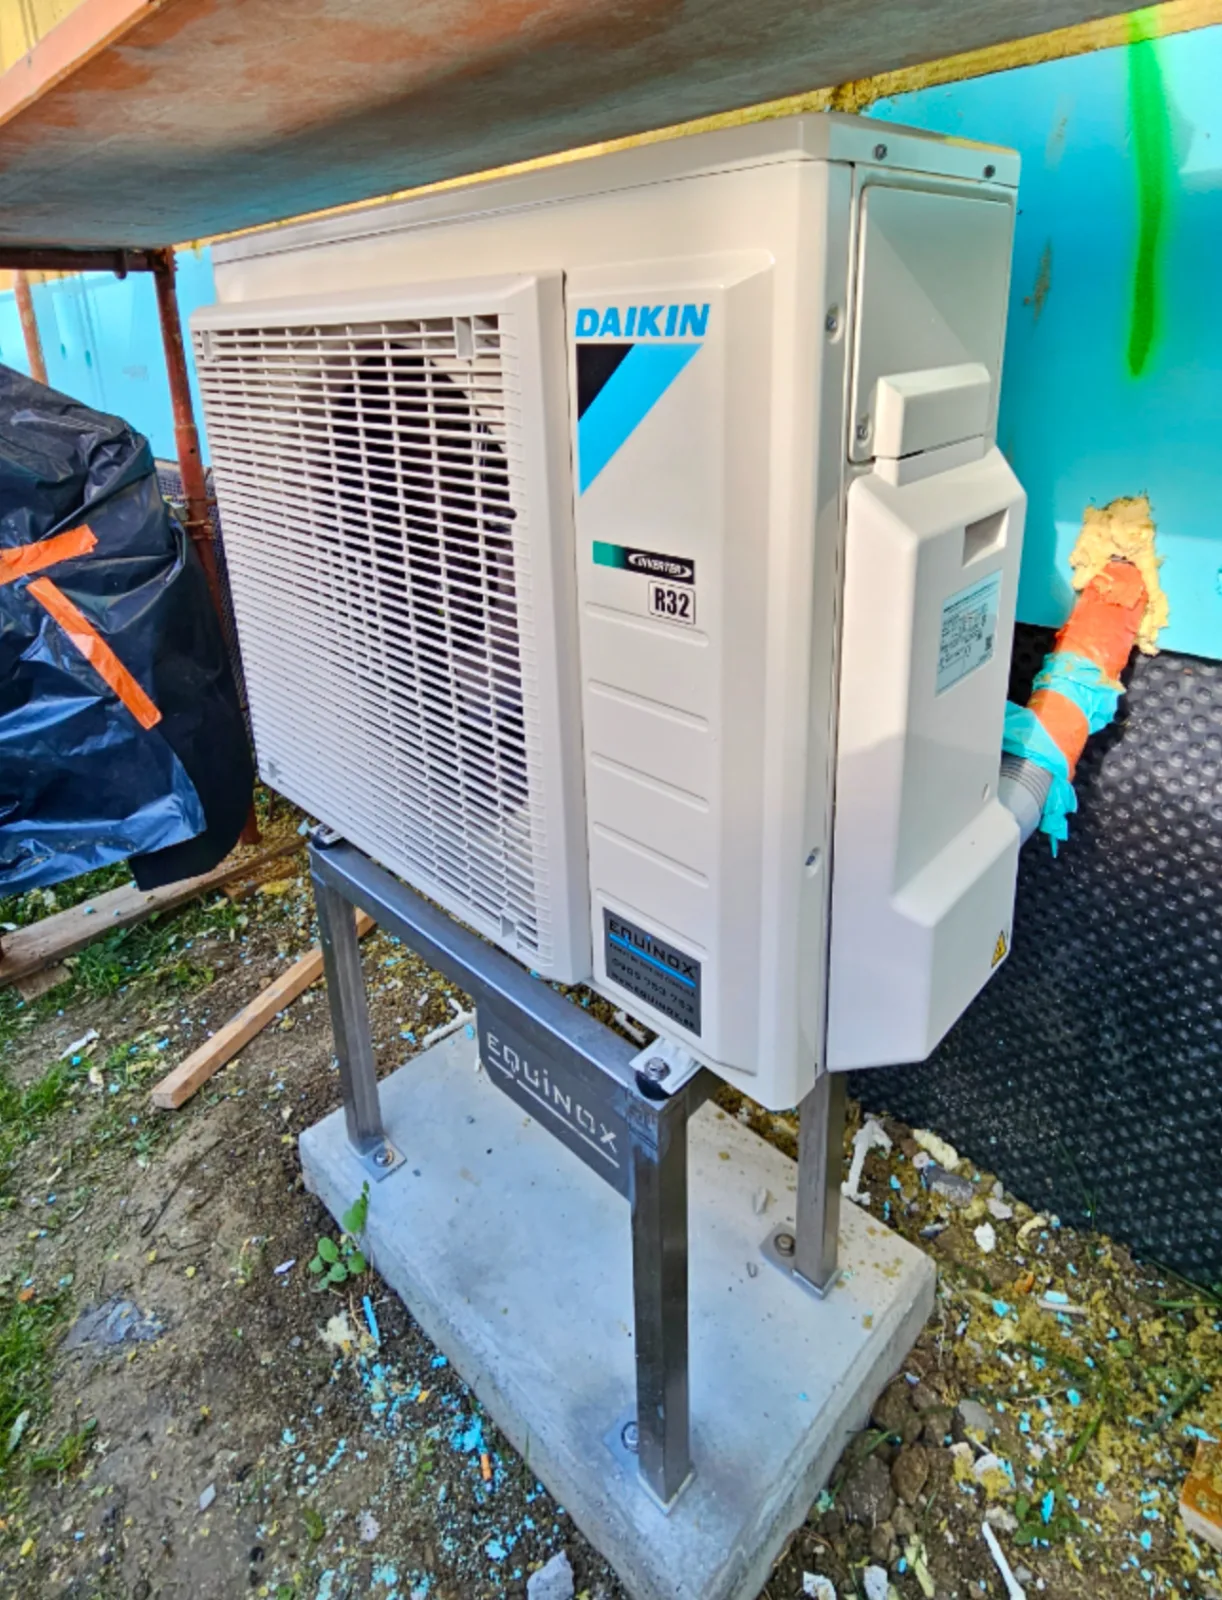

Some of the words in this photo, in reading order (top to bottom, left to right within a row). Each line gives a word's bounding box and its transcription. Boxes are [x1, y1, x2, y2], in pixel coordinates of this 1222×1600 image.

[575, 303, 711, 337] DAIKIN
[637, 557, 681, 575] INVERTER
[654, 586, 690, 618] R32
